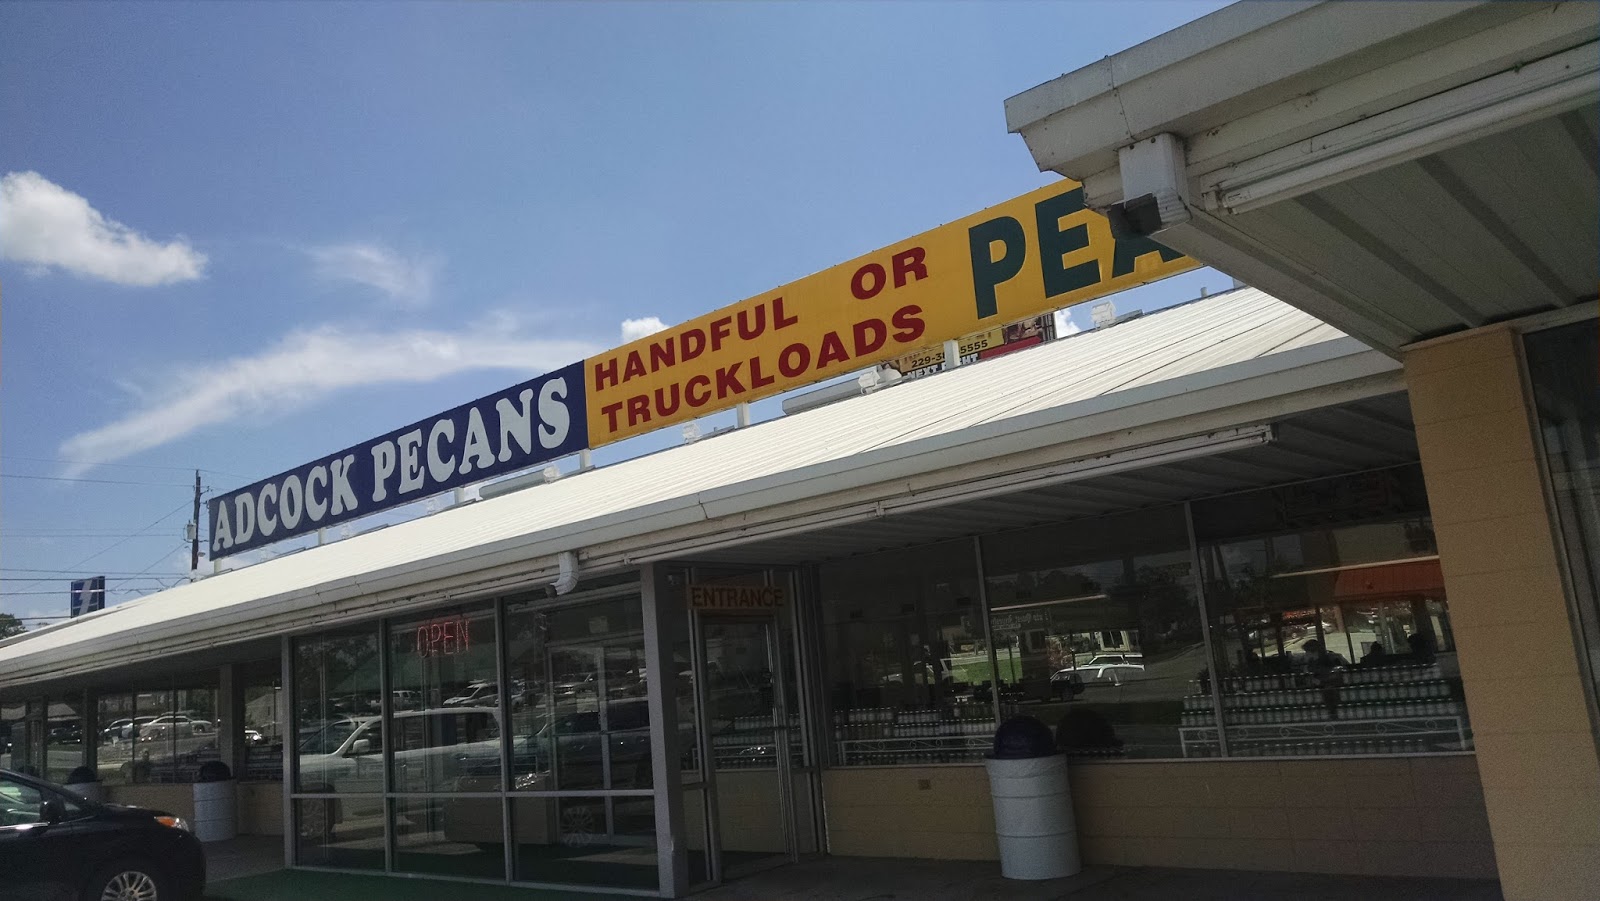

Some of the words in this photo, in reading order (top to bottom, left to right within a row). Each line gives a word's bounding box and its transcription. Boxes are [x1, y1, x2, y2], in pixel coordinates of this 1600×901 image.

[595, 297, 798, 392] HANDFUL
[850, 246, 928, 300] OR
[912, 340, 988, 368] 229-35555
[601, 304, 926, 433] TRUCKLOADS
[212, 455, 359, 552] ADCOCK
[371, 377, 571, 502] PECANS
[416, 618, 471, 658] OPEN
[691, 585, 784, 608] ENTRANCE
